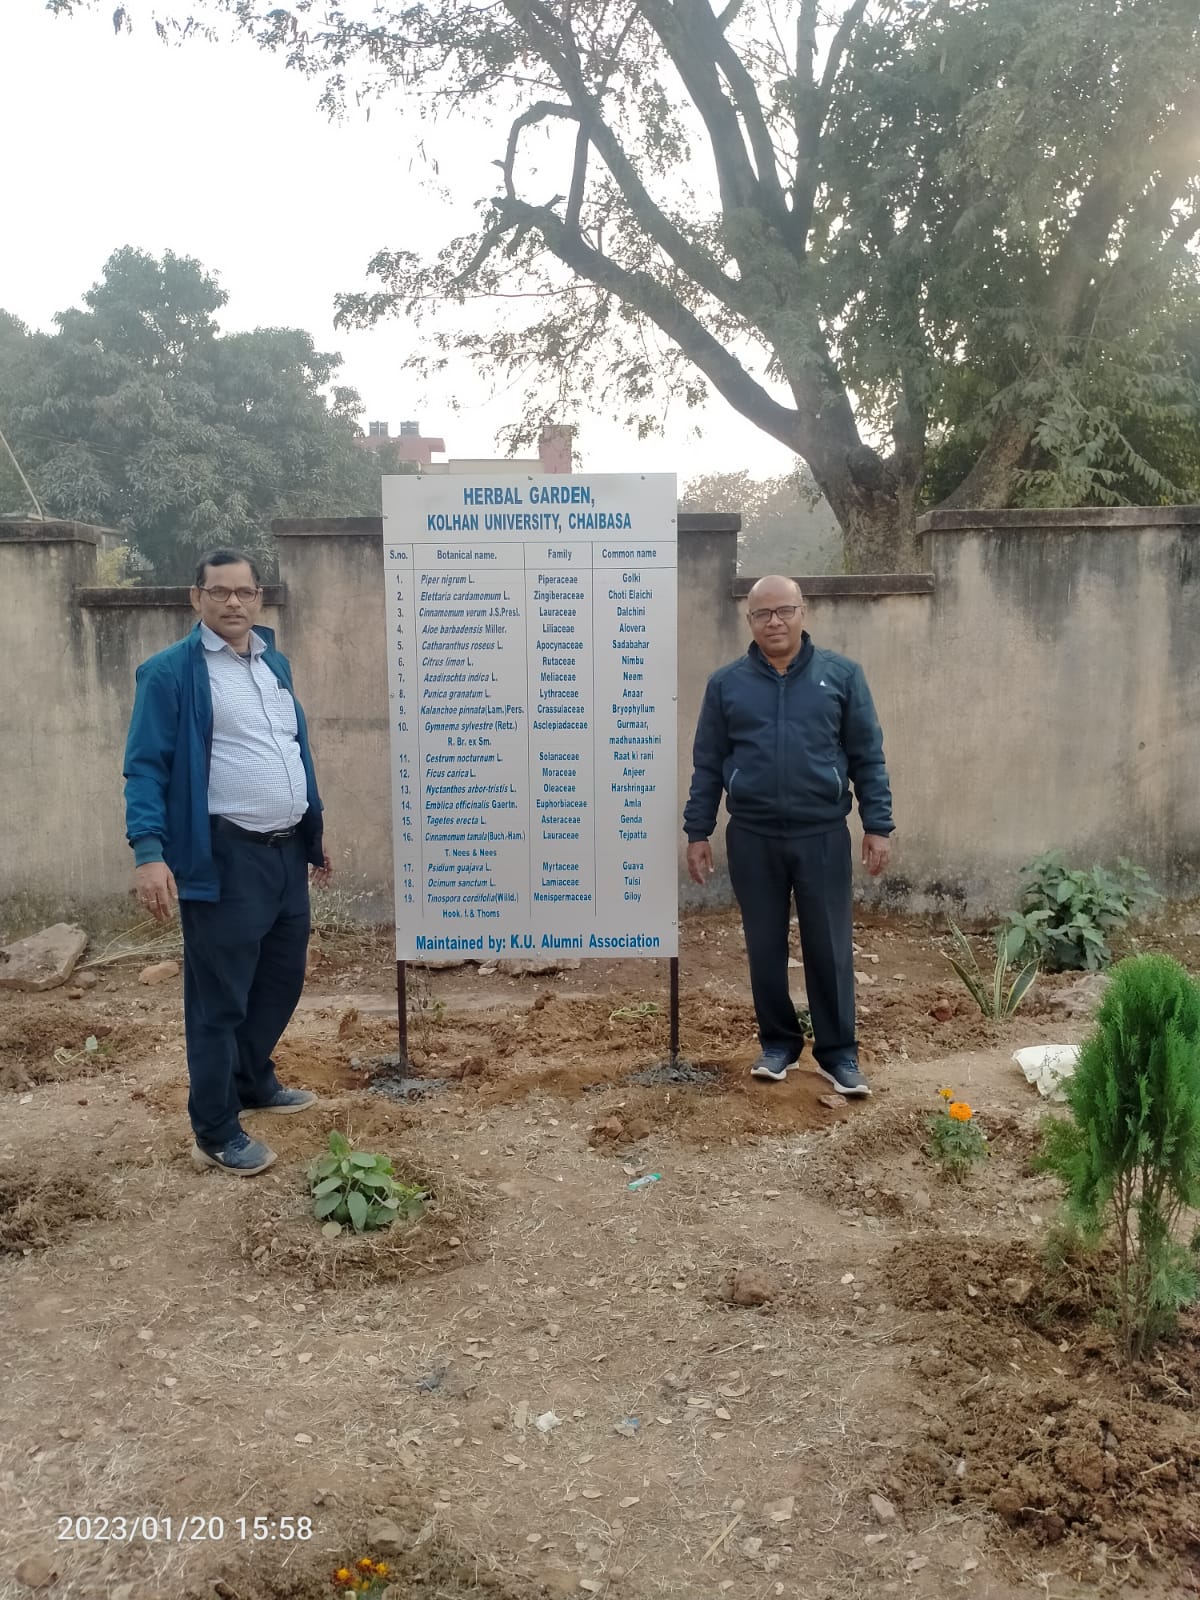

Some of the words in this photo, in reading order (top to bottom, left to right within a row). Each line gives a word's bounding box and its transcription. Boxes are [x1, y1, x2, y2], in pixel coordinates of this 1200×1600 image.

[464, 488, 523, 505] HERBAL
[530, 487, 595, 507] GARDEN,
[428, 514, 478, 530] KOLHAN
[485, 514, 562, 533] UNIVERSITY,
[569, 513, 632, 529] CHAIBASA
[390, 550, 408, 559] S.no.
[437, 549, 472, 559] Botanical
[474, 551, 497, 559] name.
[548, 549, 572, 560] Family
[602, 549, 635, 558] Common
[637, 550, 656, 558] name
[397, 575, 402, 584] 1.
[421, 575, 440, 586] Piper
[442, 575, 466, 586] nigrum
[469, 575, 475, 583] L.
[538, 575, 578, 586] Piperaceae
[623, 573, 640, 583] Golki
[397, 592, 403, 601] 2.
[421, 592, 450, 601] Elettaria
[453, 592, 501, 601] cardamomum
[504, 591, 509, 600] L.
[534, 591, 584, 602] Zingiberaceae
[609, 590, 627, 599] Choti
[629, 590, 653, 599] Elaichi
[398, 608, 403, 617] 3.
[419, 608, 464, 617] Cinnamomum
[539, 607, 576, 617] Lauraceae
[617, 607, 645, 616] Dalchini
[397, 625, 403, 634] 4.
[422, 625, 438, 634] Aloe
[440, 625, 483, 634] barbadensis
[486, 625, 506, 633] Miller.
[543, 624, 575, 633] Liliaceae
[619, 623, 645, 632] Alovera
[398, 641, 403, 649] 5.
[422, 641, 469, 650] Catharanthus
[471, 642, 494, 650] roseus
[536, 640, 583, 652] Apocynaceae
[613, 640, 649, 650] Sadabahar
[398, 658, 404, 666] 6.
[422, 658, 443, 666] Citrus
[446, 658, 465, 666] limon
[468, 657, 473, 666] L.
[542, 656, 576, 666] Rutaceae
[622, 656, 644, 665] Nimbu
[398, 674, 404, 682] 7.
[424, 673, 465, 682] Azadirachta
[468, 673, 489, 682] indica
[492, 672, 498, 681] L.
[541, 672, 576, 682] Meliaceae
[623, 672, 643, 681] Neem
[423, 690, 447, 698] Punica
[449, 690, 483, 700] granatum
[539, 689, 579, 700] Lythraceae
[623, 688, 643, 698] Anaar
[400, 706, 405, 714] 9.
[421, 706, 457, 714] Kalanchoe
[537, 704, 585, 714] Crassulaceae
[613, 704, 655, 715] Bryophyllum
[398, 723, 408, 731] 10.
[425, 722, 459, 733] Gymnema
[461, 721, 493, 732] sylvestre
[533, 720, 588, 731] Asclepiadaceae
[617, 720, 649, 731] Gurmaar,
[457, 737, 466, 746] Br.
[479, 737, 491, 745] Sm.
[609, 736, 661, 745] madhunaashini
[400, 754, 410, 763] 11.
[426, 754, 455, 763] Cestrum
[457, 754, 494, 762] nocturnum
[539, 752, 579, 761] Solanaceae
[614, 752, 630, 761] Raat
[632, 751, 638, 760] ki
[640, 752, 654, 760] rani
[400, 769, 409, 778] 12.
[426, 769, 445, 778] Ficus
[447, 769, 468, 777] carica
[542, 768, 576, 777] Moraceae
[623, 767, 645, 778] Anjeer
[401, 785, 411, 794] 13.
[468, 785, 508, 793] arbor-tristis
[544, 783, 576, 793] Oleaceae
[612, 783, 656, 794] Harshringaar
[402, 801, 411, 810] 14.
[426, 801, 453, 809] Emblica
[455, 801, 489, 809] officinalis
[536, 799, 588, 809] Euphorbiaceae
[624, 798, 642, 808] Amla
[402, 817, 412, 825] 15.
[427, 816, 454, 826] Tagetes
[456, 816, 478, 824] erecta
[481, 816, 486, 824] L.
[541, 815, 581, 824] Asteraceae
[620, 815, 642, 824] Genda
[403, 833, 413, 841] 16.
[425, 833, 465, 841] Cinnamomum
[543, 831, 579, 840] Lauraceae
[619, 830, 647, 840] Tejpatta
[403, 864, 413, 872] 17.
[428, 864, 455, 872] Psidium
[457, 864, 483, 873] guajava
[543, 862, 579, 872] Myrtaceae
[623, 862, 644, 870] Guava
[404, 879, 414, 888] 18.
[428, 879, 456, 887] Ocimum
[457, 879, 487, 887] sanctum
[542, 877, 579, 886] Lamiaceae
[624, 877, 641, 886] Tulsi
[404, 895, 414, 903] 19.
[427, 894, 460, 904] Tinospora
[534, 892, 592, 903] Menispermaceae
[624, 891, 642, 902] Giloy
[443, 910, 462, 918] Hook.
[478, 909, 500, 917] Thoms
[416, 935, 485, 950] Maintained
[488, 935, 506, 951] by:
[510, 935, 535, 949] K.U.
[541, 934, 583, 948] Alumni
[589, 933, 660, 948] Association
